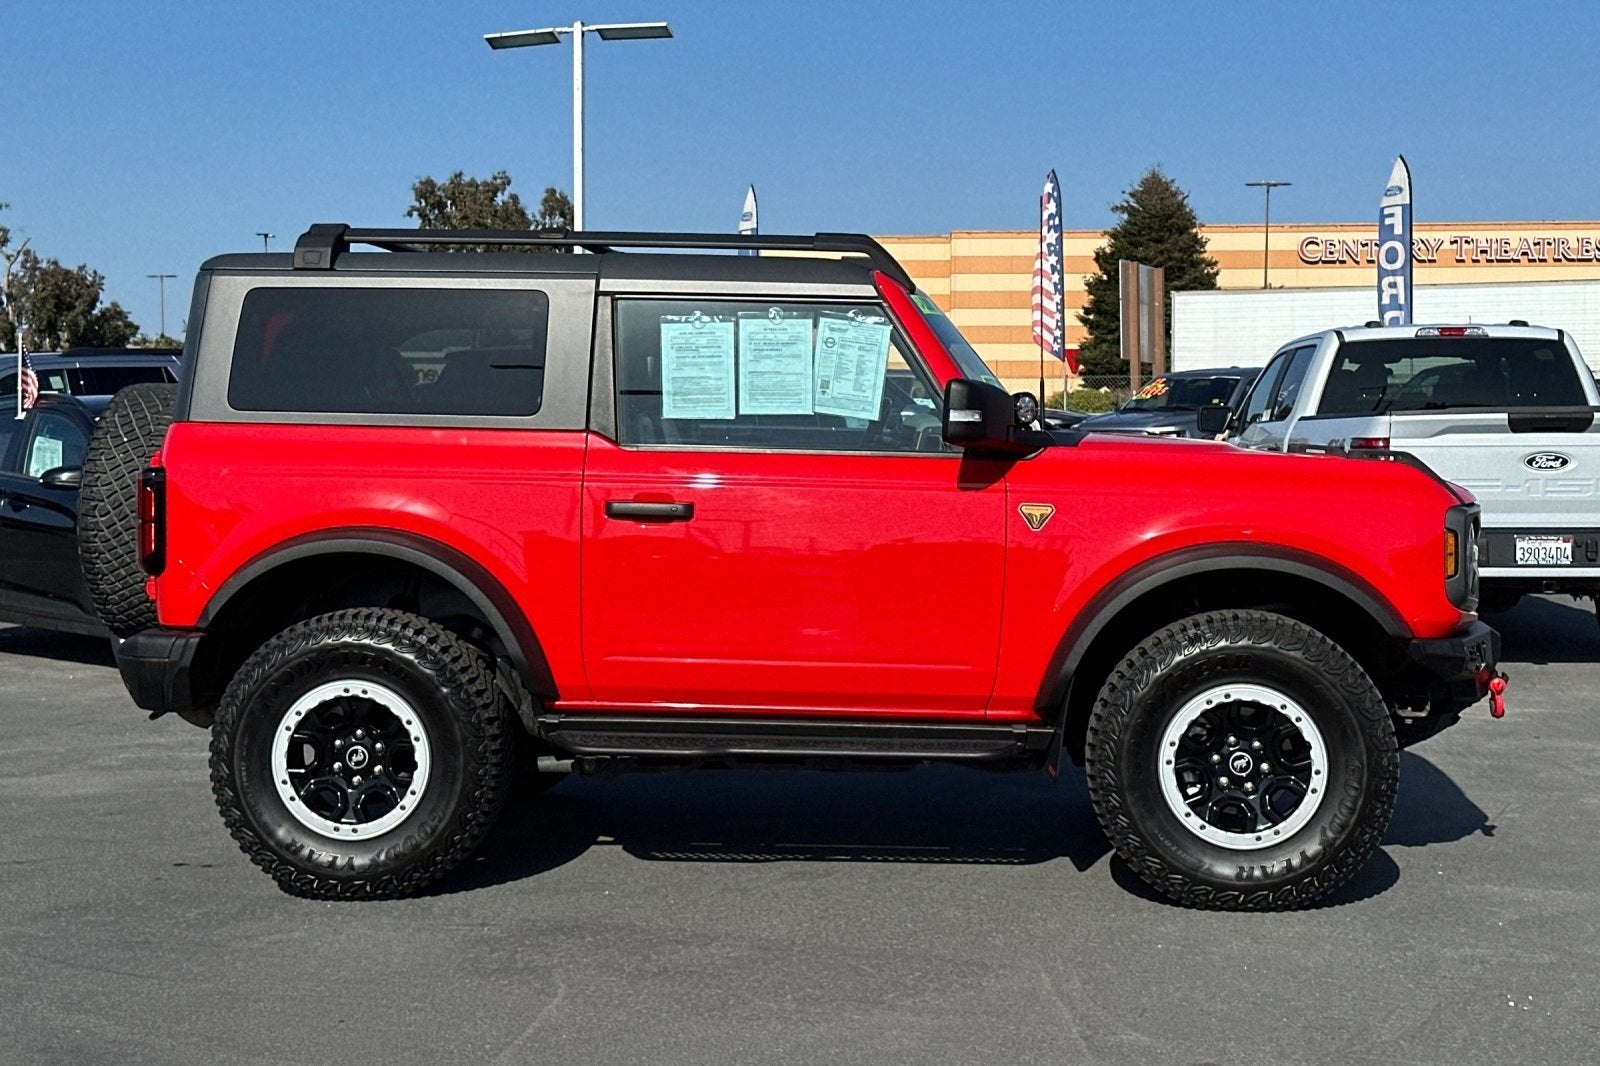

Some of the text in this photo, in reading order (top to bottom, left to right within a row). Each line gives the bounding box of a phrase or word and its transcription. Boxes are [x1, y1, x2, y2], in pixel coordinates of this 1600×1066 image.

[1298, 236, 1443, 264] CENTRY
[1531, 454, 1563, 469] Ford
[1450, 478, 1600, 497] F-15
